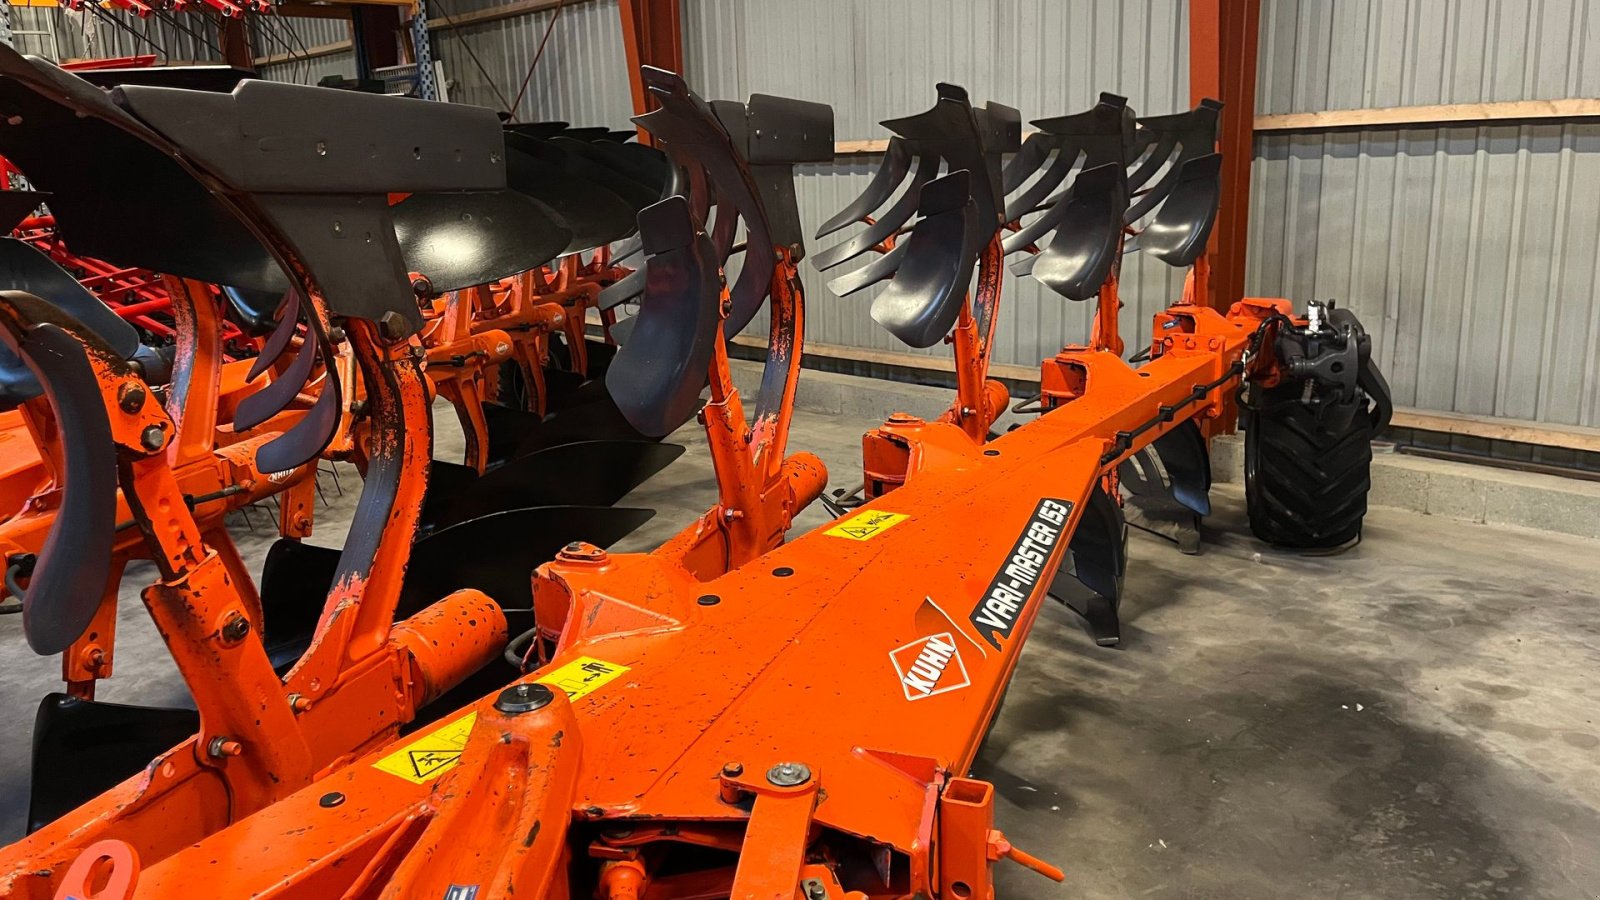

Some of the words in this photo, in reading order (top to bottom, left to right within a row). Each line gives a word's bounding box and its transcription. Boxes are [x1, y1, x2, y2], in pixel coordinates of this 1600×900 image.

[976, 521, 1058, 630] VARI-MASTER
[1037, 499, 1068, 526] 153
[903, 636, 956, 695] KUHN
